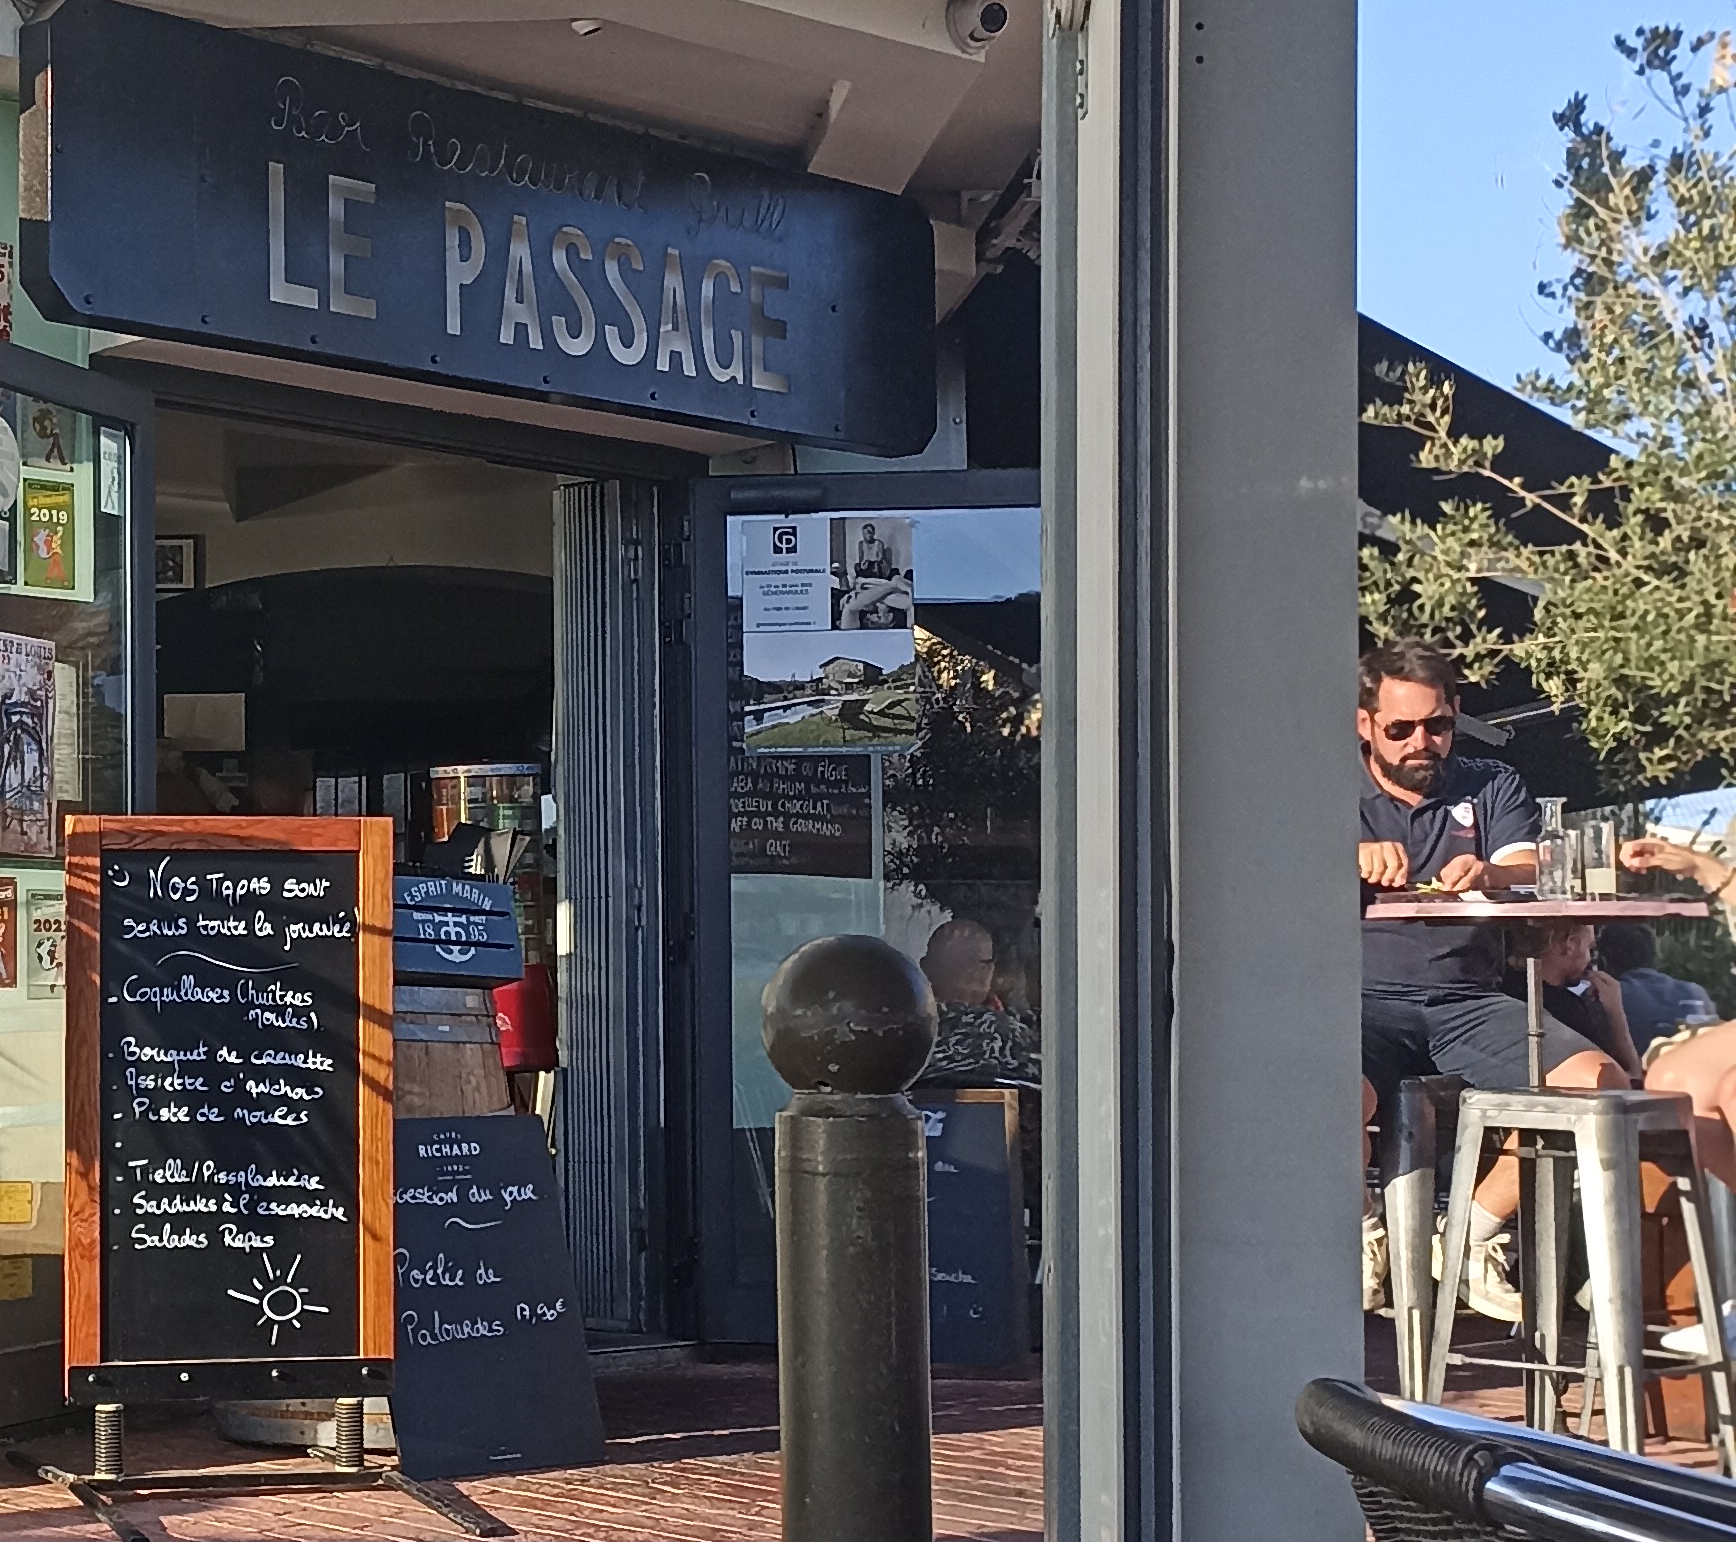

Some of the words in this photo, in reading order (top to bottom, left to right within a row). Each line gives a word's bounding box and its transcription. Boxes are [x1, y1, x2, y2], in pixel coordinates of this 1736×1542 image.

[271, 77, 370, 151] Bar
[269, 161, 377, 320] LE
[445, 201, 790, 394] PASSAGE
[30, 507, 68, 524] 2019
[403, 879, 448, 905] ESPRIT
[452, 881, 493, 911] MARIN
[33, 918, 66, 932] 202
[196, 912, 248, 936] toute
[254, 910, 274, 937] la
[418, 922, 435, 940] 18
[121, 1036, 209, 1073] Bouquet
[216, 1045, 244, 1065] de
[126, 1067, 209, 1096] Assiette
[195, 1105, 225, 1123] de
[418, 1142, 481, 1158] RICHARD
[221, 1193, 239, 1214] à
[468, 1184, 495, 1203] du
[499, 1182, 540, 1211] jour
[130, 1224, 209, 1250] Salades
[219, 1223, 275, 1254] Repas
[476, 1259, 505, 1285] de
[400, 1309, 506, 1347] Palourdes
